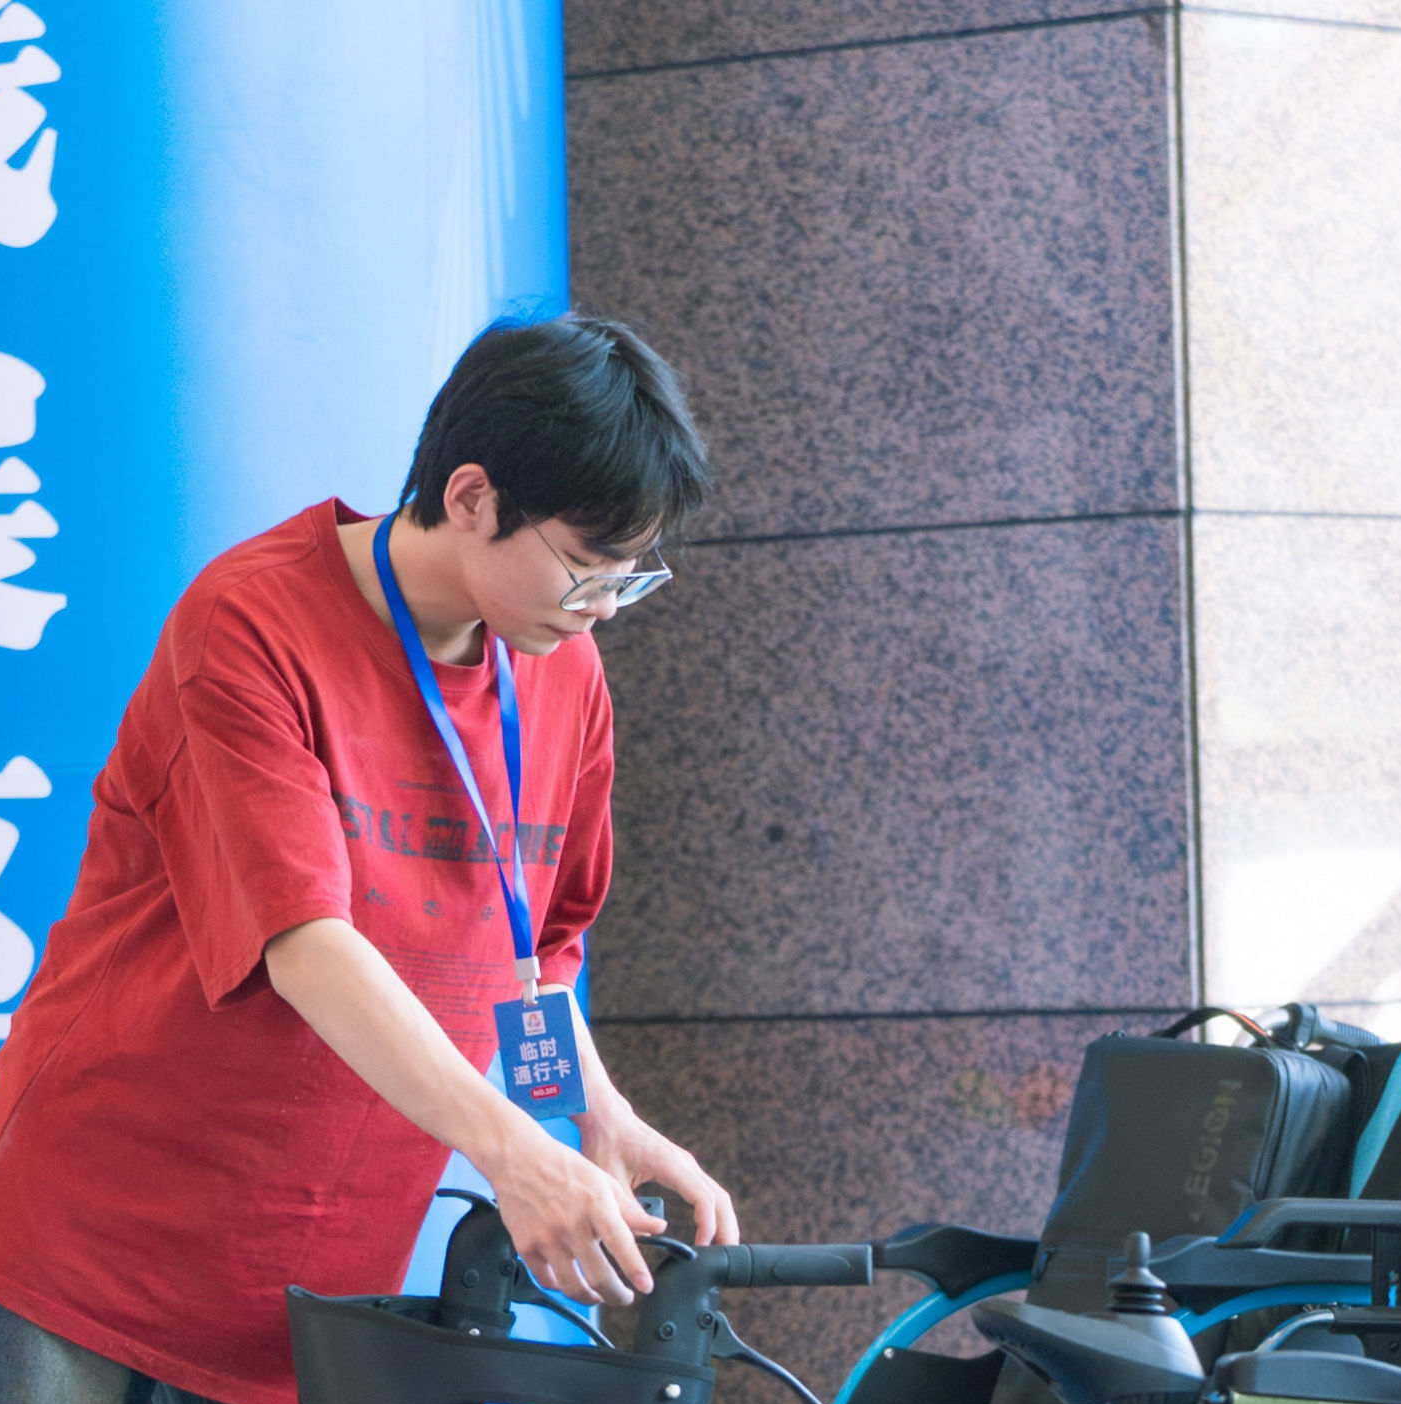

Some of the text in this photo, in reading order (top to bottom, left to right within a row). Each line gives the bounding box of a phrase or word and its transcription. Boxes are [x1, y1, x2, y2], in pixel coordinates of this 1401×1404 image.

[519, 1037, 557, 1062] 临时
[513, 1058, 571, 1086] 通行卡
